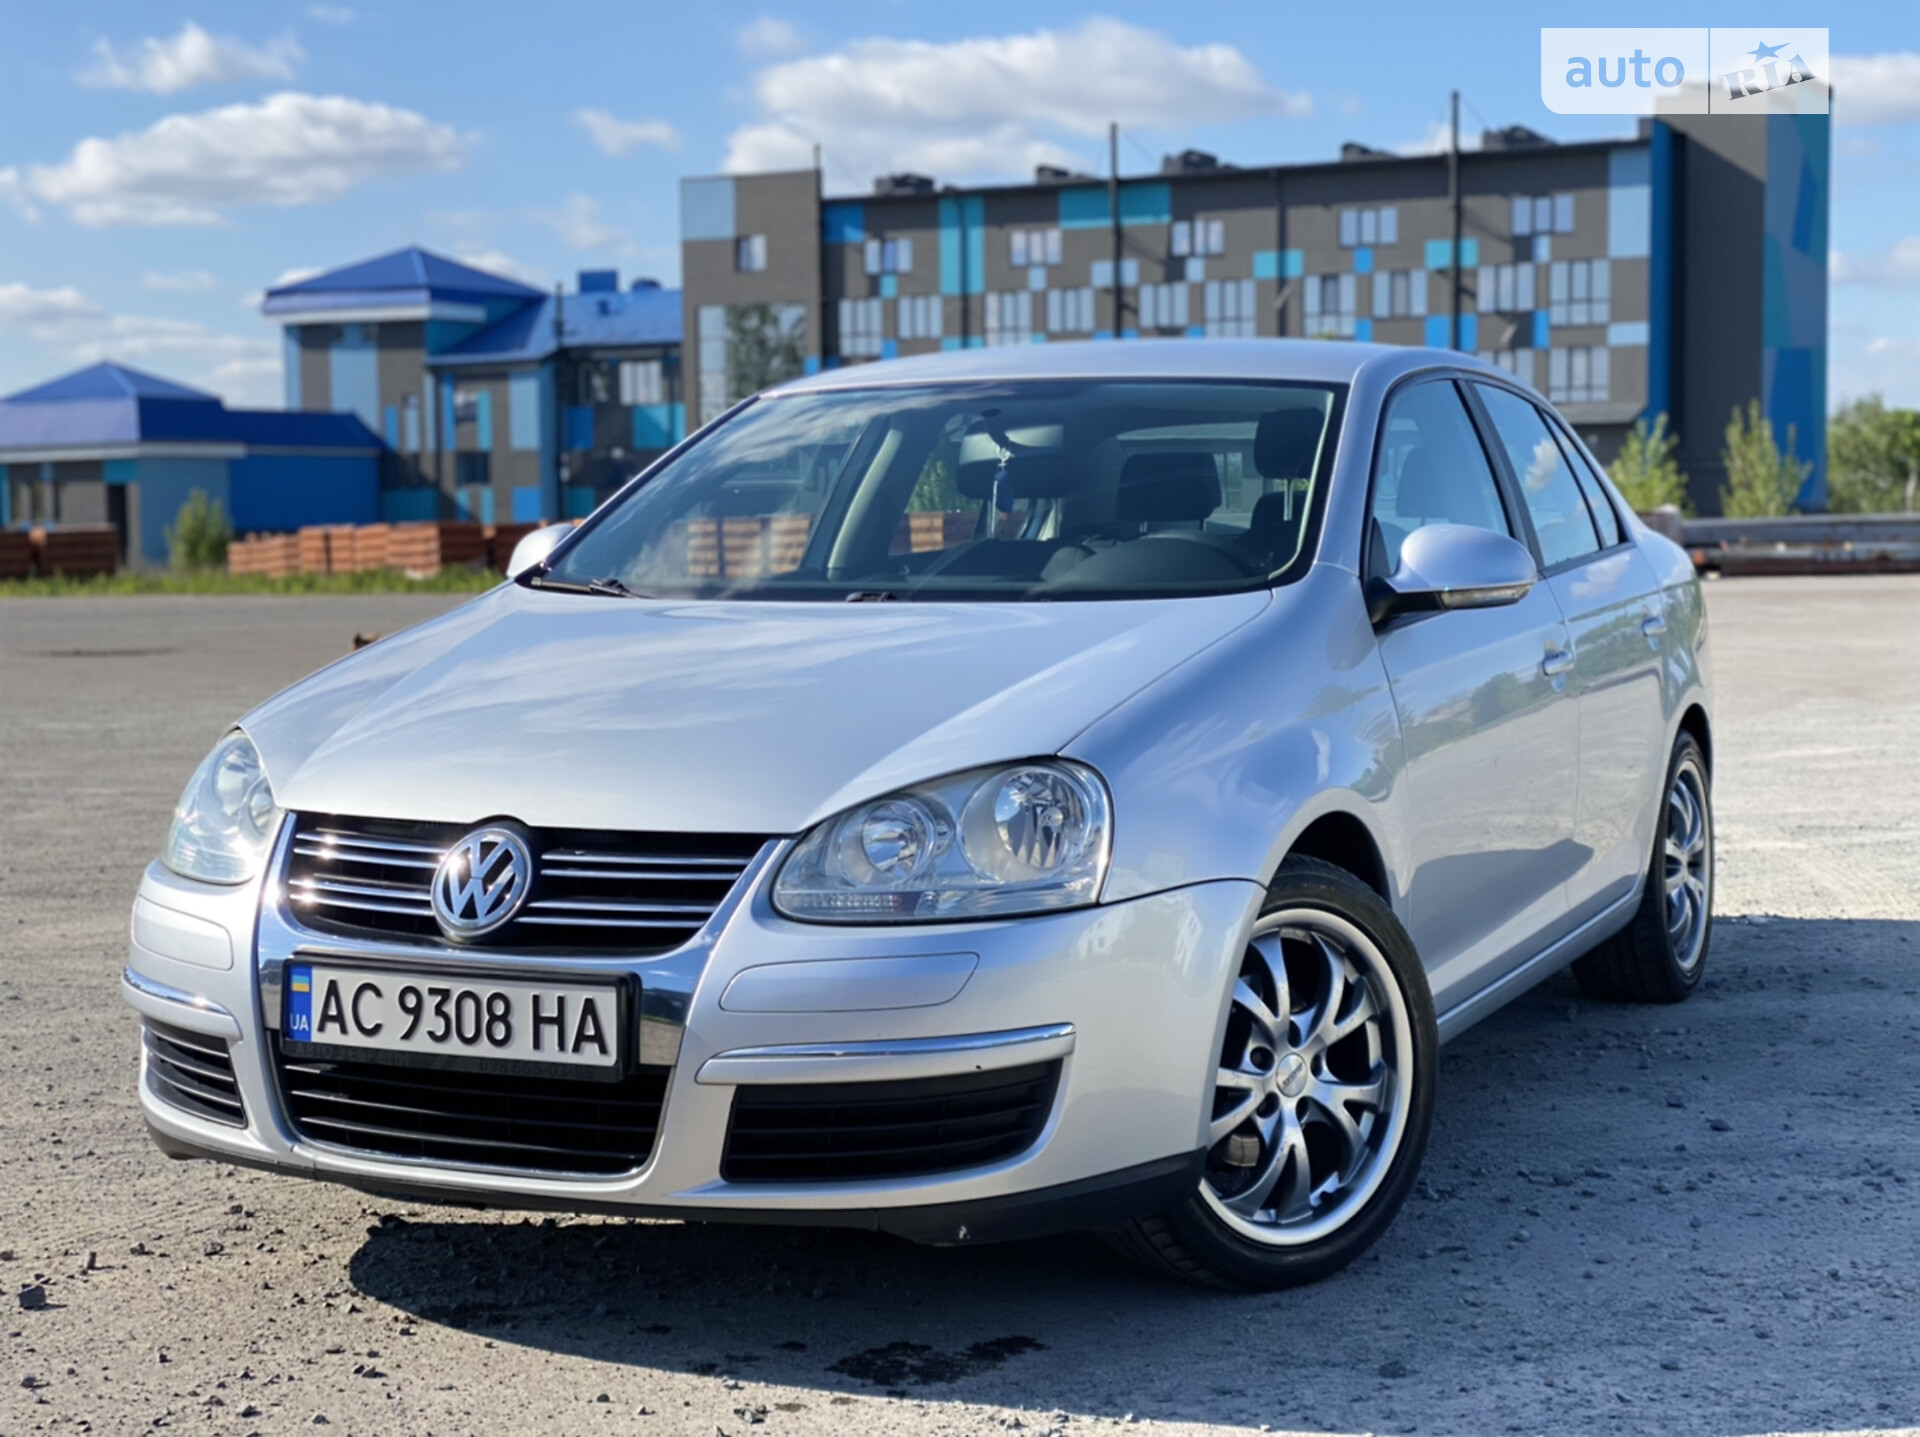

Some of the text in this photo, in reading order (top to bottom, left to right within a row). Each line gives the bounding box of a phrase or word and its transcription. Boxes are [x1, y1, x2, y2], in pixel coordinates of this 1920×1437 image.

[290, 1014, 309, 1031] UA
[317, 979, 608, 1055] AC 9308 HA
